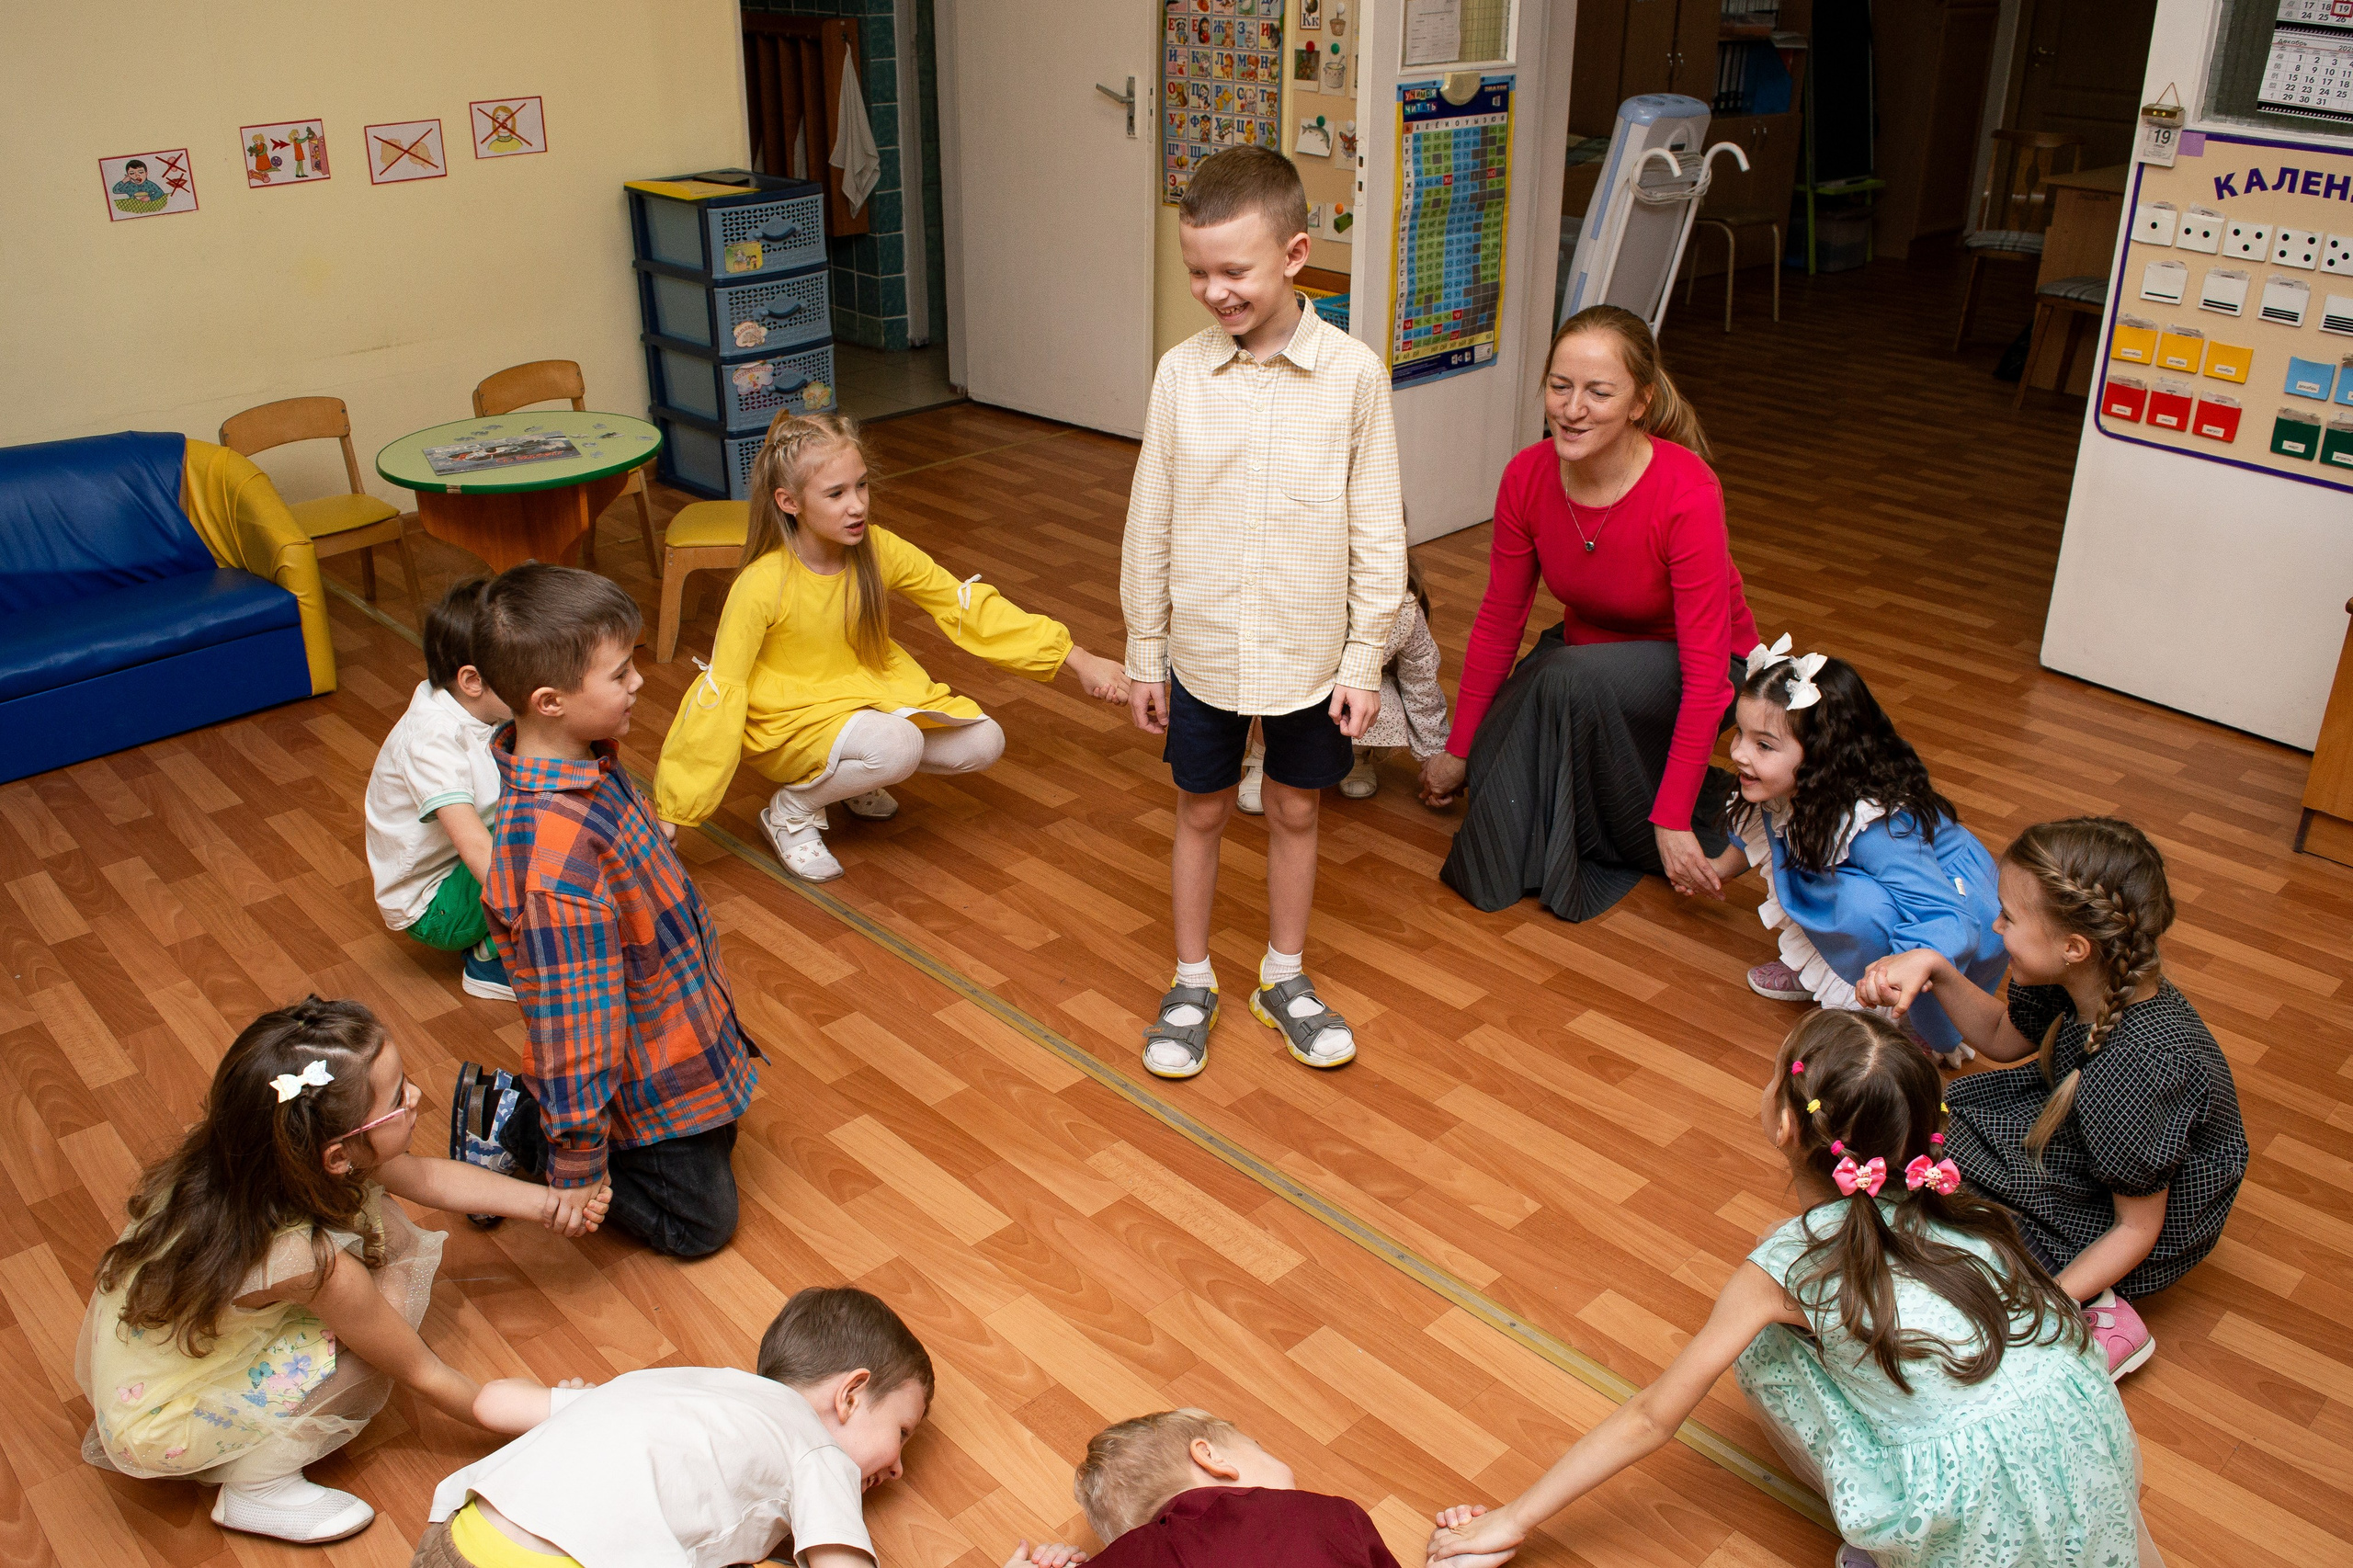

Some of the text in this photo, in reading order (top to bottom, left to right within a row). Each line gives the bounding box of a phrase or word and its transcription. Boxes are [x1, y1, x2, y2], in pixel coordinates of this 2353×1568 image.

[2322, 3, 2331, 11] 18
[1168, 17, 1175, 30] Е
[1213, 20, 1225, 33] Ж
[1238, 22, 1245, 34] З
[1261, 23, 1269, 37] И
[1302, 13, 1319, 27] Кк
[1168, 46, 1268, 69] Й К Л М Н
[1167, 82, 1267, 103] О П Р С Т
[1405, 89, 1437, 100] УЧИМСЯ
[1405, 102, 1437, 112] ЧИТАТЬ
[1168, 113, 1266, 135] У Ф Х Ц Ч
[2154, 130, 2171, 144] 19
[1169, 175, 1176, 187] Э
[2214, 167, 2353, 202] КАЛЕН
